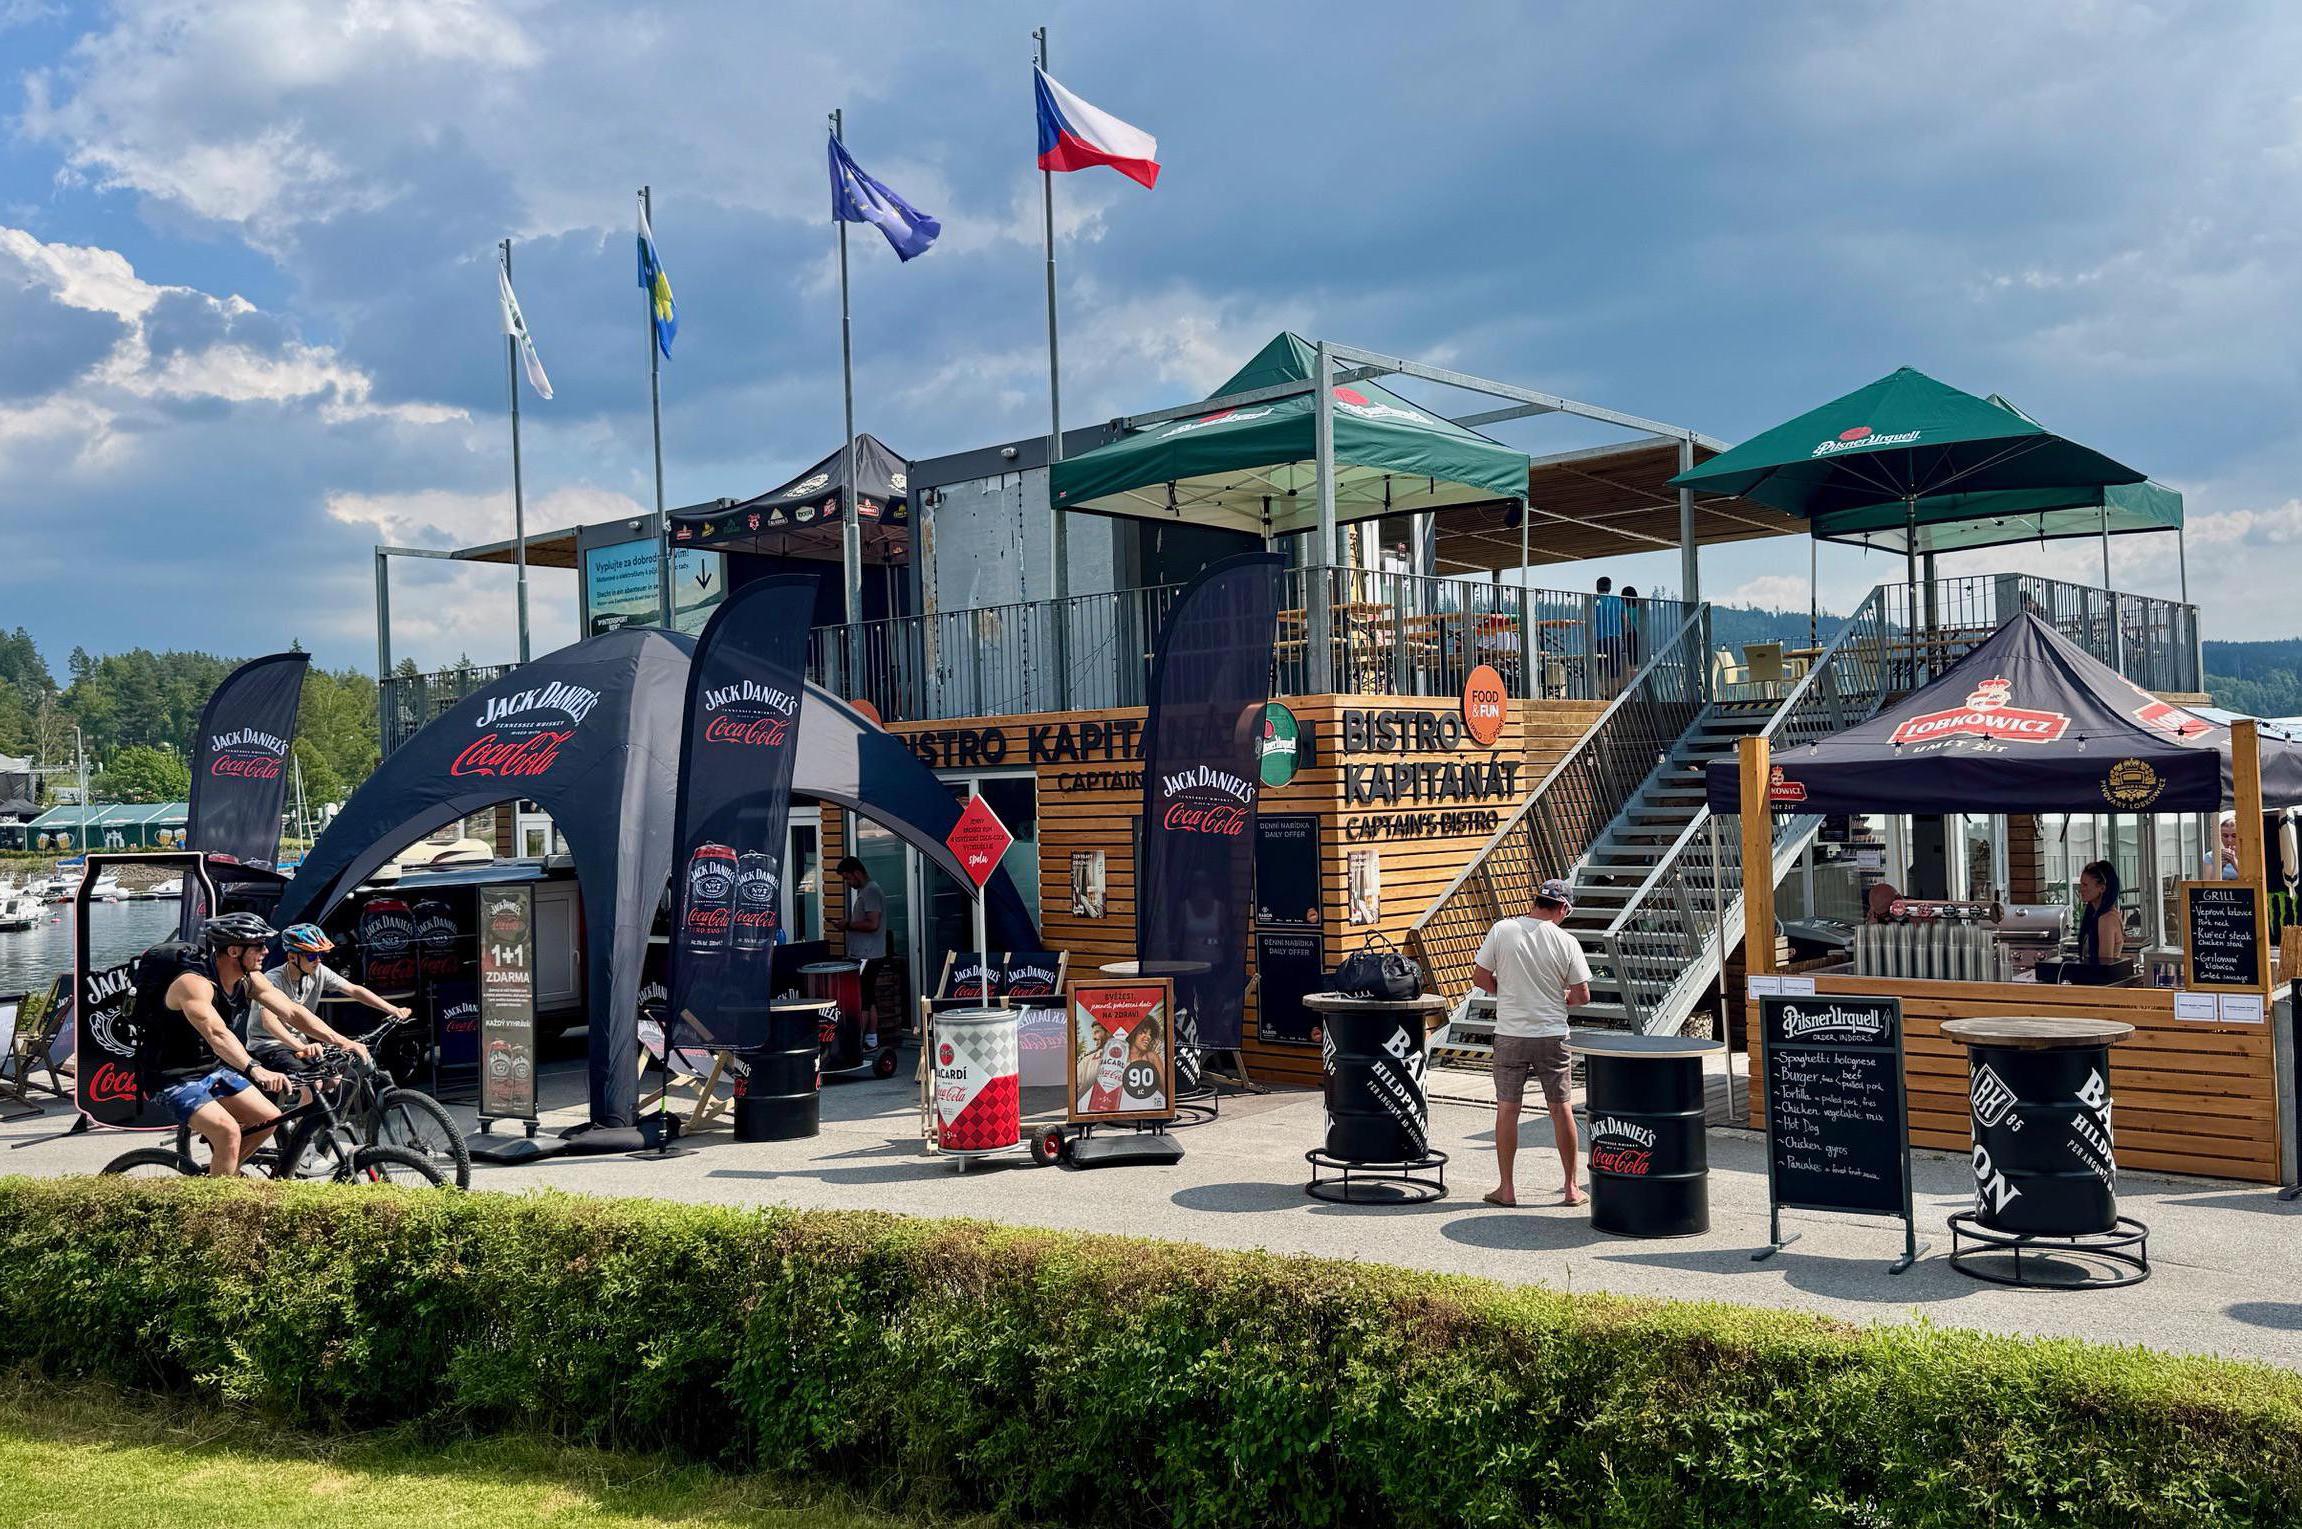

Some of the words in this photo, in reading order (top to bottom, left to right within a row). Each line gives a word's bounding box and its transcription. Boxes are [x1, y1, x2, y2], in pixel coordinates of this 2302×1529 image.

[705, 684, 742, 712] JACK
[1472, 690, 1500, 703] FOOD
[476, 688, 543, 728] JACK
[1479, 704, 1500, 718] FUN
[1343, 710, 1462, 751] BISTRO
[1904, 712, 2053, 738] LOBKOWICZ
[211, 731, 241, 752] JACK
[1163, 769, 1198, 798] JACK
[1345, 751, 1521, 807] KAPITANÁT
[1440, 809, 1500, 834] BISTRO
[2202, 889, 2236, 901] GRILL
[2228, 932, 2252, 941] steak
[491, 943, 524, 968] 1+1
[1288, 948, 1311, 956] OFFER
[485, 971, 531, 984] ZDARMA
[955, 967, 973, 983] JACK
[1008, 969, 1026, 984] JACK
[86, 966, 133, 1005] JACK
[1102, 1011, 1113, 1019] NA
[1782, 1005, 1833, 1039] Pilsner
[1812, 1033, 1838, 1042] ORDER
[1839, 1034, 1873, 1042] INDOORS
[1779, 1052, 1830, 1068] Spaghetti
[1128, 1067, 1154, 1087] 90
[1842, 1069, 1862, 1080] beef
[1781, 1085, 1812, 1101] Tortilla
[1781, 1101, 1821, 1116] Chicken
[1865, 1112, 1885, 1122] mix
[1589, 1119, 1608, 1141] JACK
[1783, 1115, 1800, 1131] Hot
[1803, 1118, 1820, 1136] Dog
[2005, 1113, 2025, 1133] 85
[1785, 1136, 1822, 1151] Chicken
